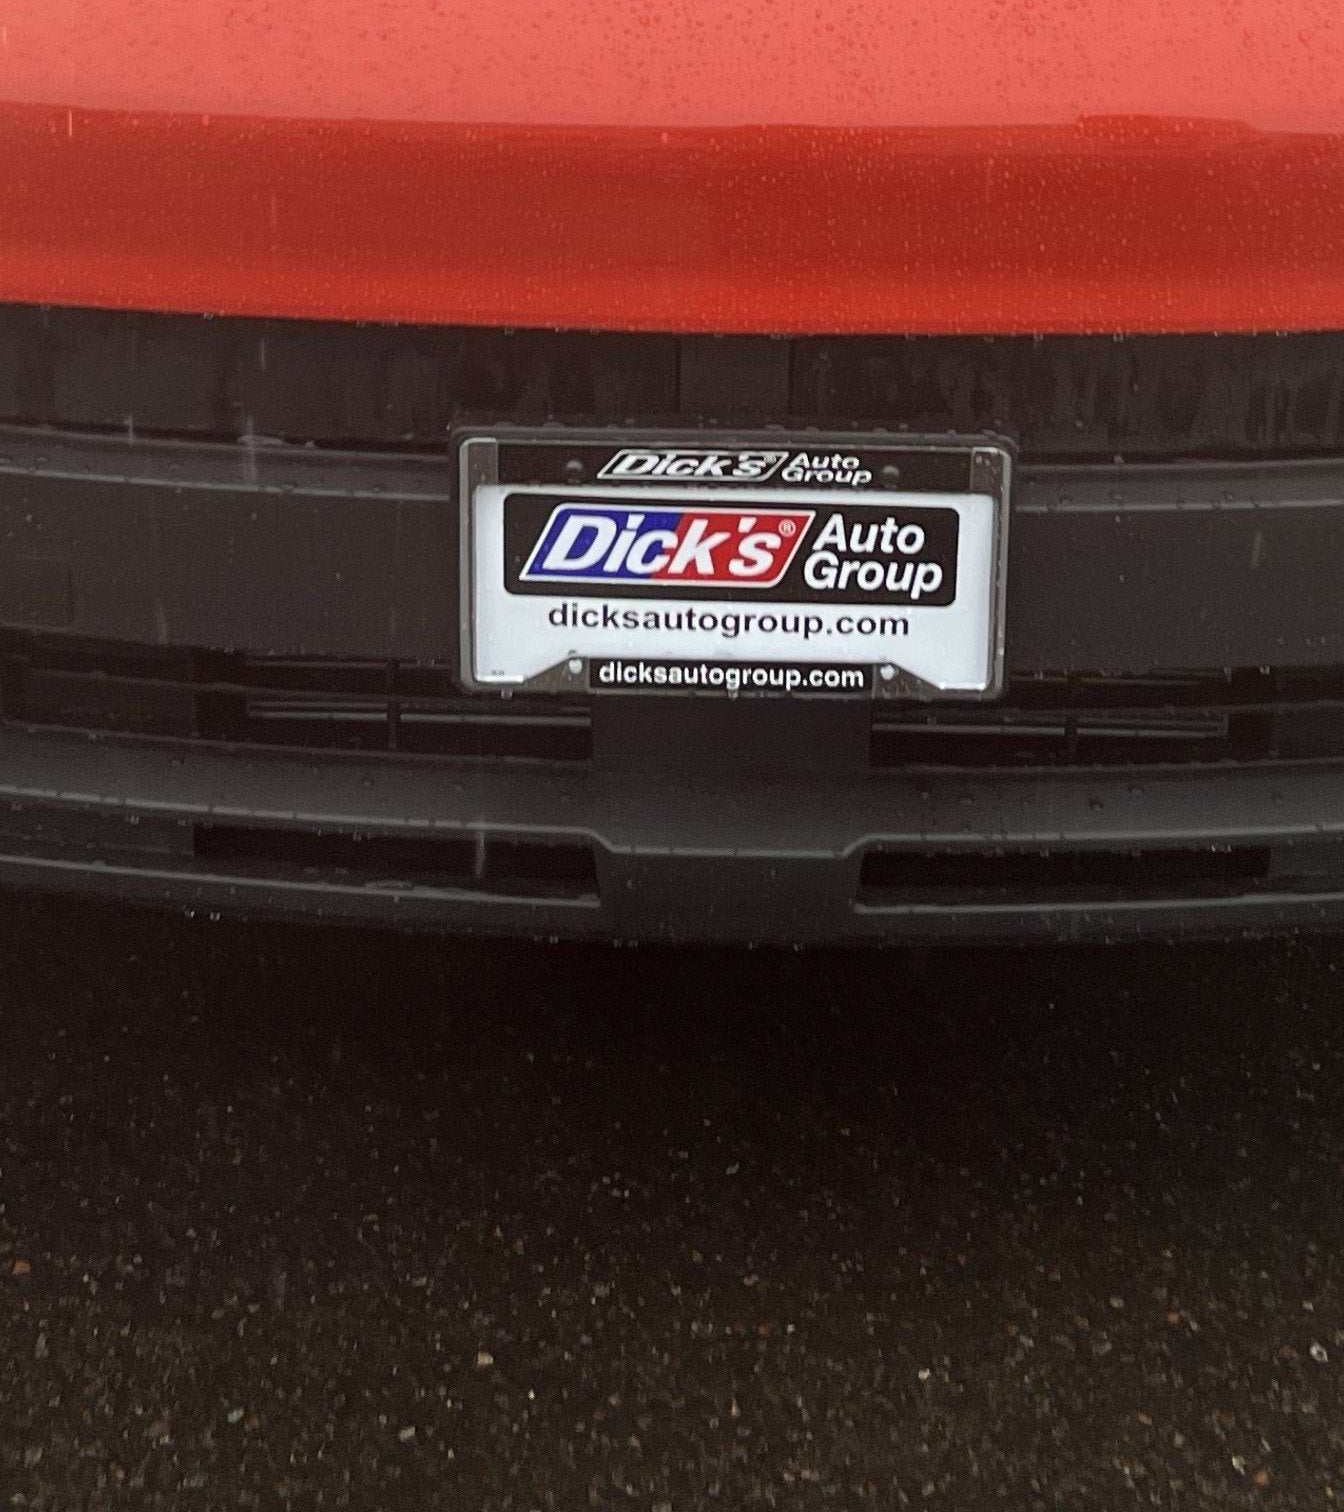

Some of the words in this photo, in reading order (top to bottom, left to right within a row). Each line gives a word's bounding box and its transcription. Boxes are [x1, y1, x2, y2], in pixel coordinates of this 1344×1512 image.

[781, 466, 873, 487] Group
[788, 453, 861, 469] Auto
[812, 514, 925, 556] Auto
[804, 552, 943, 598] Group
[548, 603, 910, 640] dicksautogroup.com
[599, 663, 865, 691] dicksautogroup.com
